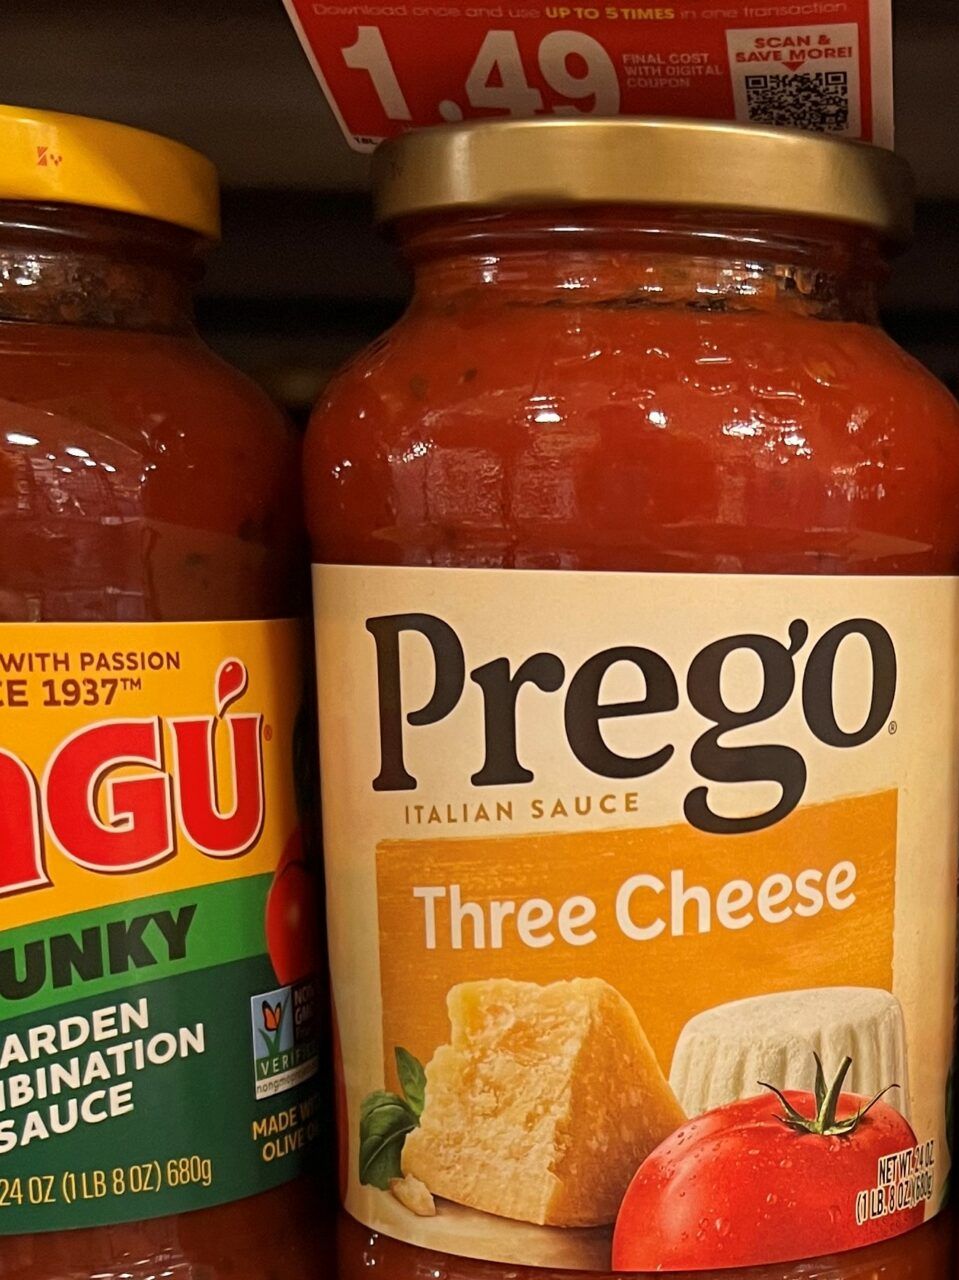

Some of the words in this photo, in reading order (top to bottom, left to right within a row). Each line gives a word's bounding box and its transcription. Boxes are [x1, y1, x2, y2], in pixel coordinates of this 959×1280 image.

[312, 4, 407, 18] Download
[413, 6, 460, 18] once
[465, 6, 503, 18] and
[508, 9, 540, 19] use
[545, 8, 570, 19] UP
[573, 8, 599, 20] TO
[605, 7, 618, 20] 5
[621, 7, 675, 20] TIMES
[680, 6, 697, 20] in
[702, 8, 738, 20] one
[735, 50, 782, 63] SAVE
[789, 46, 852, 62] MORE!
[755, 34, 810, 49] SCAN
[818, 34, 831, 46] &
[341, 25, 620, 121] 1.49
[622, 52, 665, 65] FINAL
[668, 52, 710, 65] COST
[624, 65, 662, 76] WITH
[665, 64, 723, 77] DIGITAL
[626, 77, 690, 89] COUPON
[0, 652, 70, 673] WITH
[80, 651, 181, 672] PASSION
[0, 679, 29, 708] E
[366, 613, 897, 835] Prego
[405, 801, 514, 825] ITALIAN
[531, 792, 640, 820] SAUCE
[413, 884, 597, 950] Three
[615, 860, 857, 941] Cheese
[0, 1023, 206, 1112] BINATION
[0, 1081, 134, 1154] SAUCE
[252, 1107, 298, 1141] MADE
[262, 1129, 304, 1162] OLIVE
[0, 1178, 23, 1206] 24
[28, 1175, 56, 1204] OZ
[62, 1171, 76, 1204] (1
[82, 1170, 107, 1199] LB
[112, 1167, 126, 1195] 8
[129, 1160, 162, 1193] OZ)
[166, 1155, 212, 1187] 680g
[879, 1155, 897, 1186] NET
[857, 1192, 868, 1225] (1
[871, 1188, 887, 1218] LB.
[889, 1184, 896, 1212] 8
